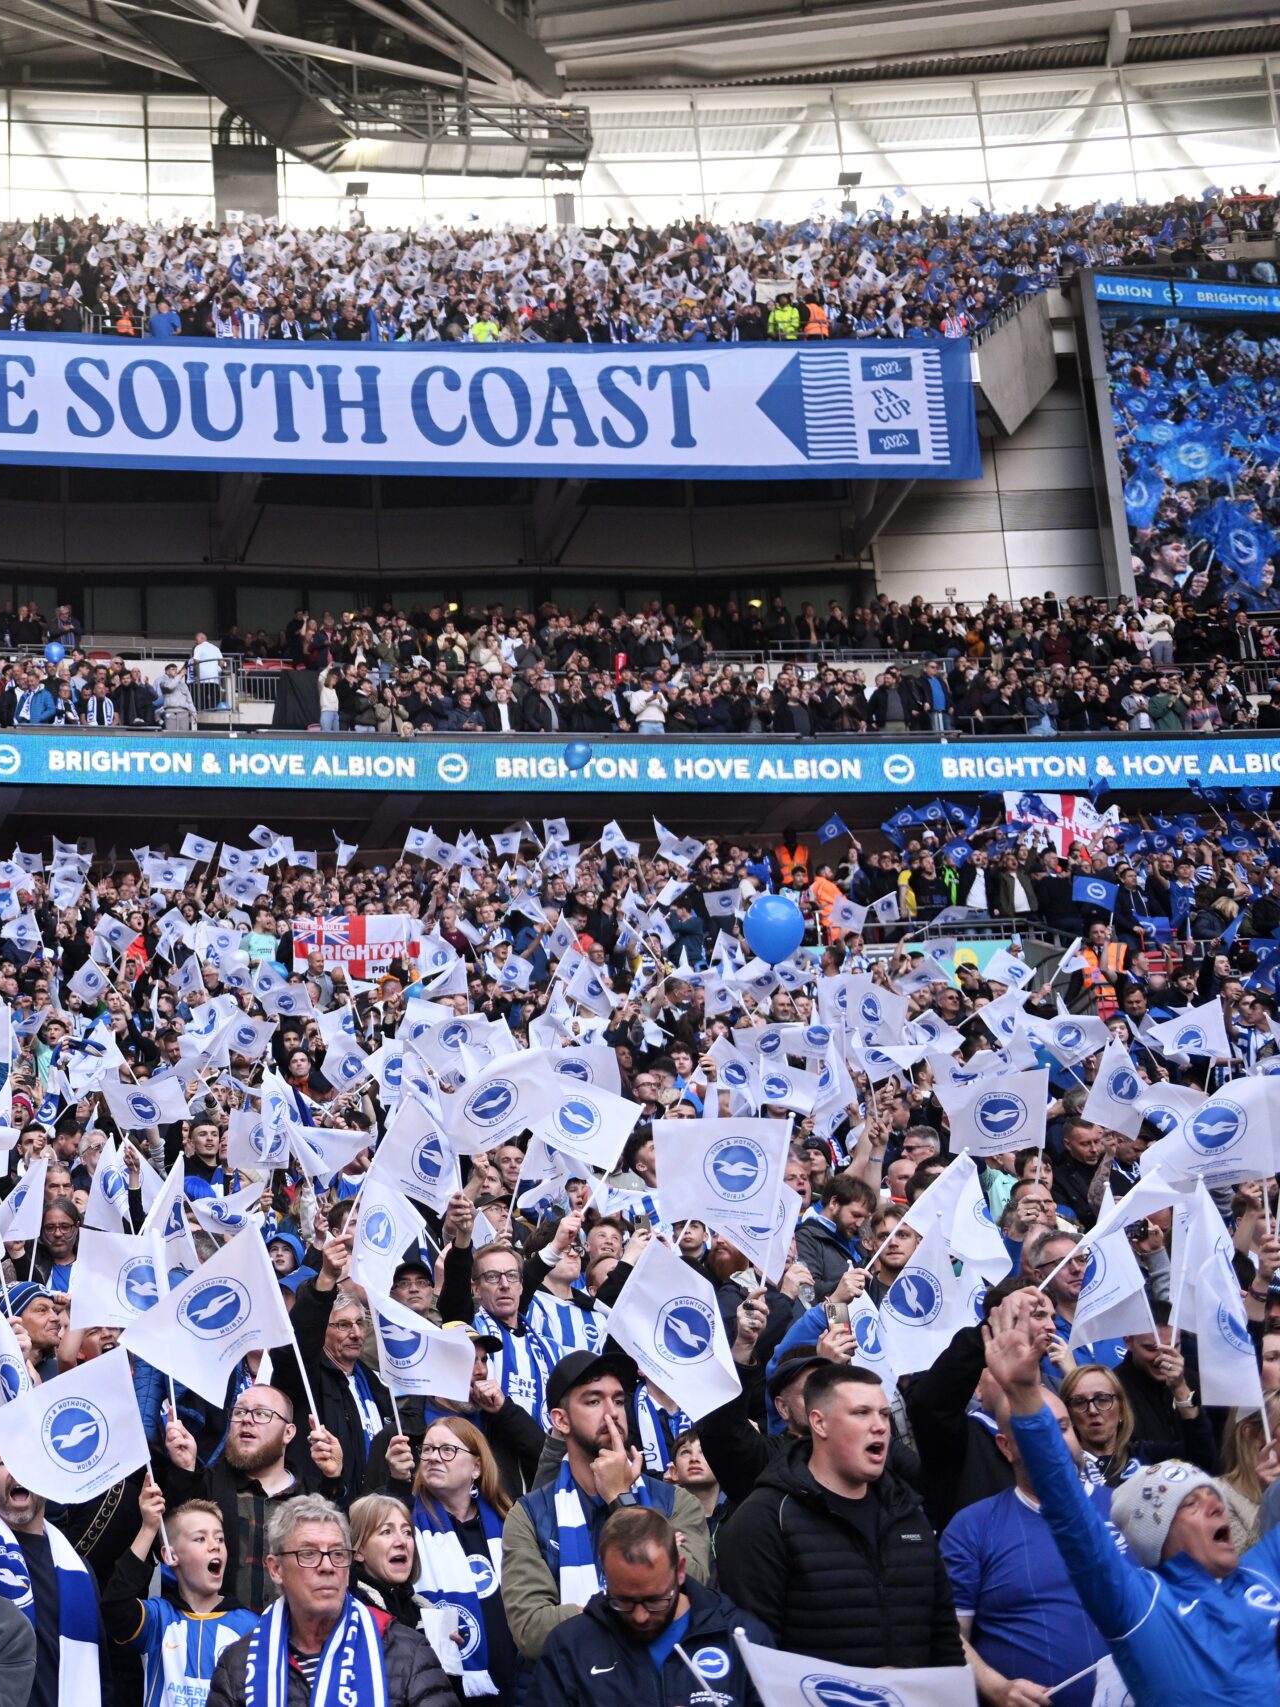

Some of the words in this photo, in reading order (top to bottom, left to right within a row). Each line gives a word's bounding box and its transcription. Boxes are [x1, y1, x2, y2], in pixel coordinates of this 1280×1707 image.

[1096, 283, 1153, 299] ALBION
[1196, 291, 1269, 306] BRIGHTON
[871, 361, 902, 378] 2022
[65, 356, 388, 444] SOUTH
[411, 363, 710, 449] COAST
[871, 386, 899, 405] FA
[874, 399, 911, 423] CUP
[879, 433, 910, 451] 2023
[49, 750, 193, 774] BRIGHTON
[202, 753, 222, 775] &
[229, 753, 305, 776] HOVE
[312, 755, 416, 779] ALBION
[647, 758, 667, 779] &
[675, 758, 750, 780] HOVE
[757, 758, 862, 780] ALBION
[942, 756, 1087, 779] BRIGHTON
[1096, 755, 1116, 777] &
[1124, 755, 1201, 777] HOVE
[468, 1085, 488, 1107] BRIGHTON
[488, 1111, 508, 1125] ALBION
[916, 1270, 940, 1295] BRIGHTON
[931, 1301, 940, 1316] HOVE
[674, 1300, 706, 1313] BRIGHTON
[658, 1342, 677, 1361] ALBION
[167, 1683, 206, 1699] AMERI
